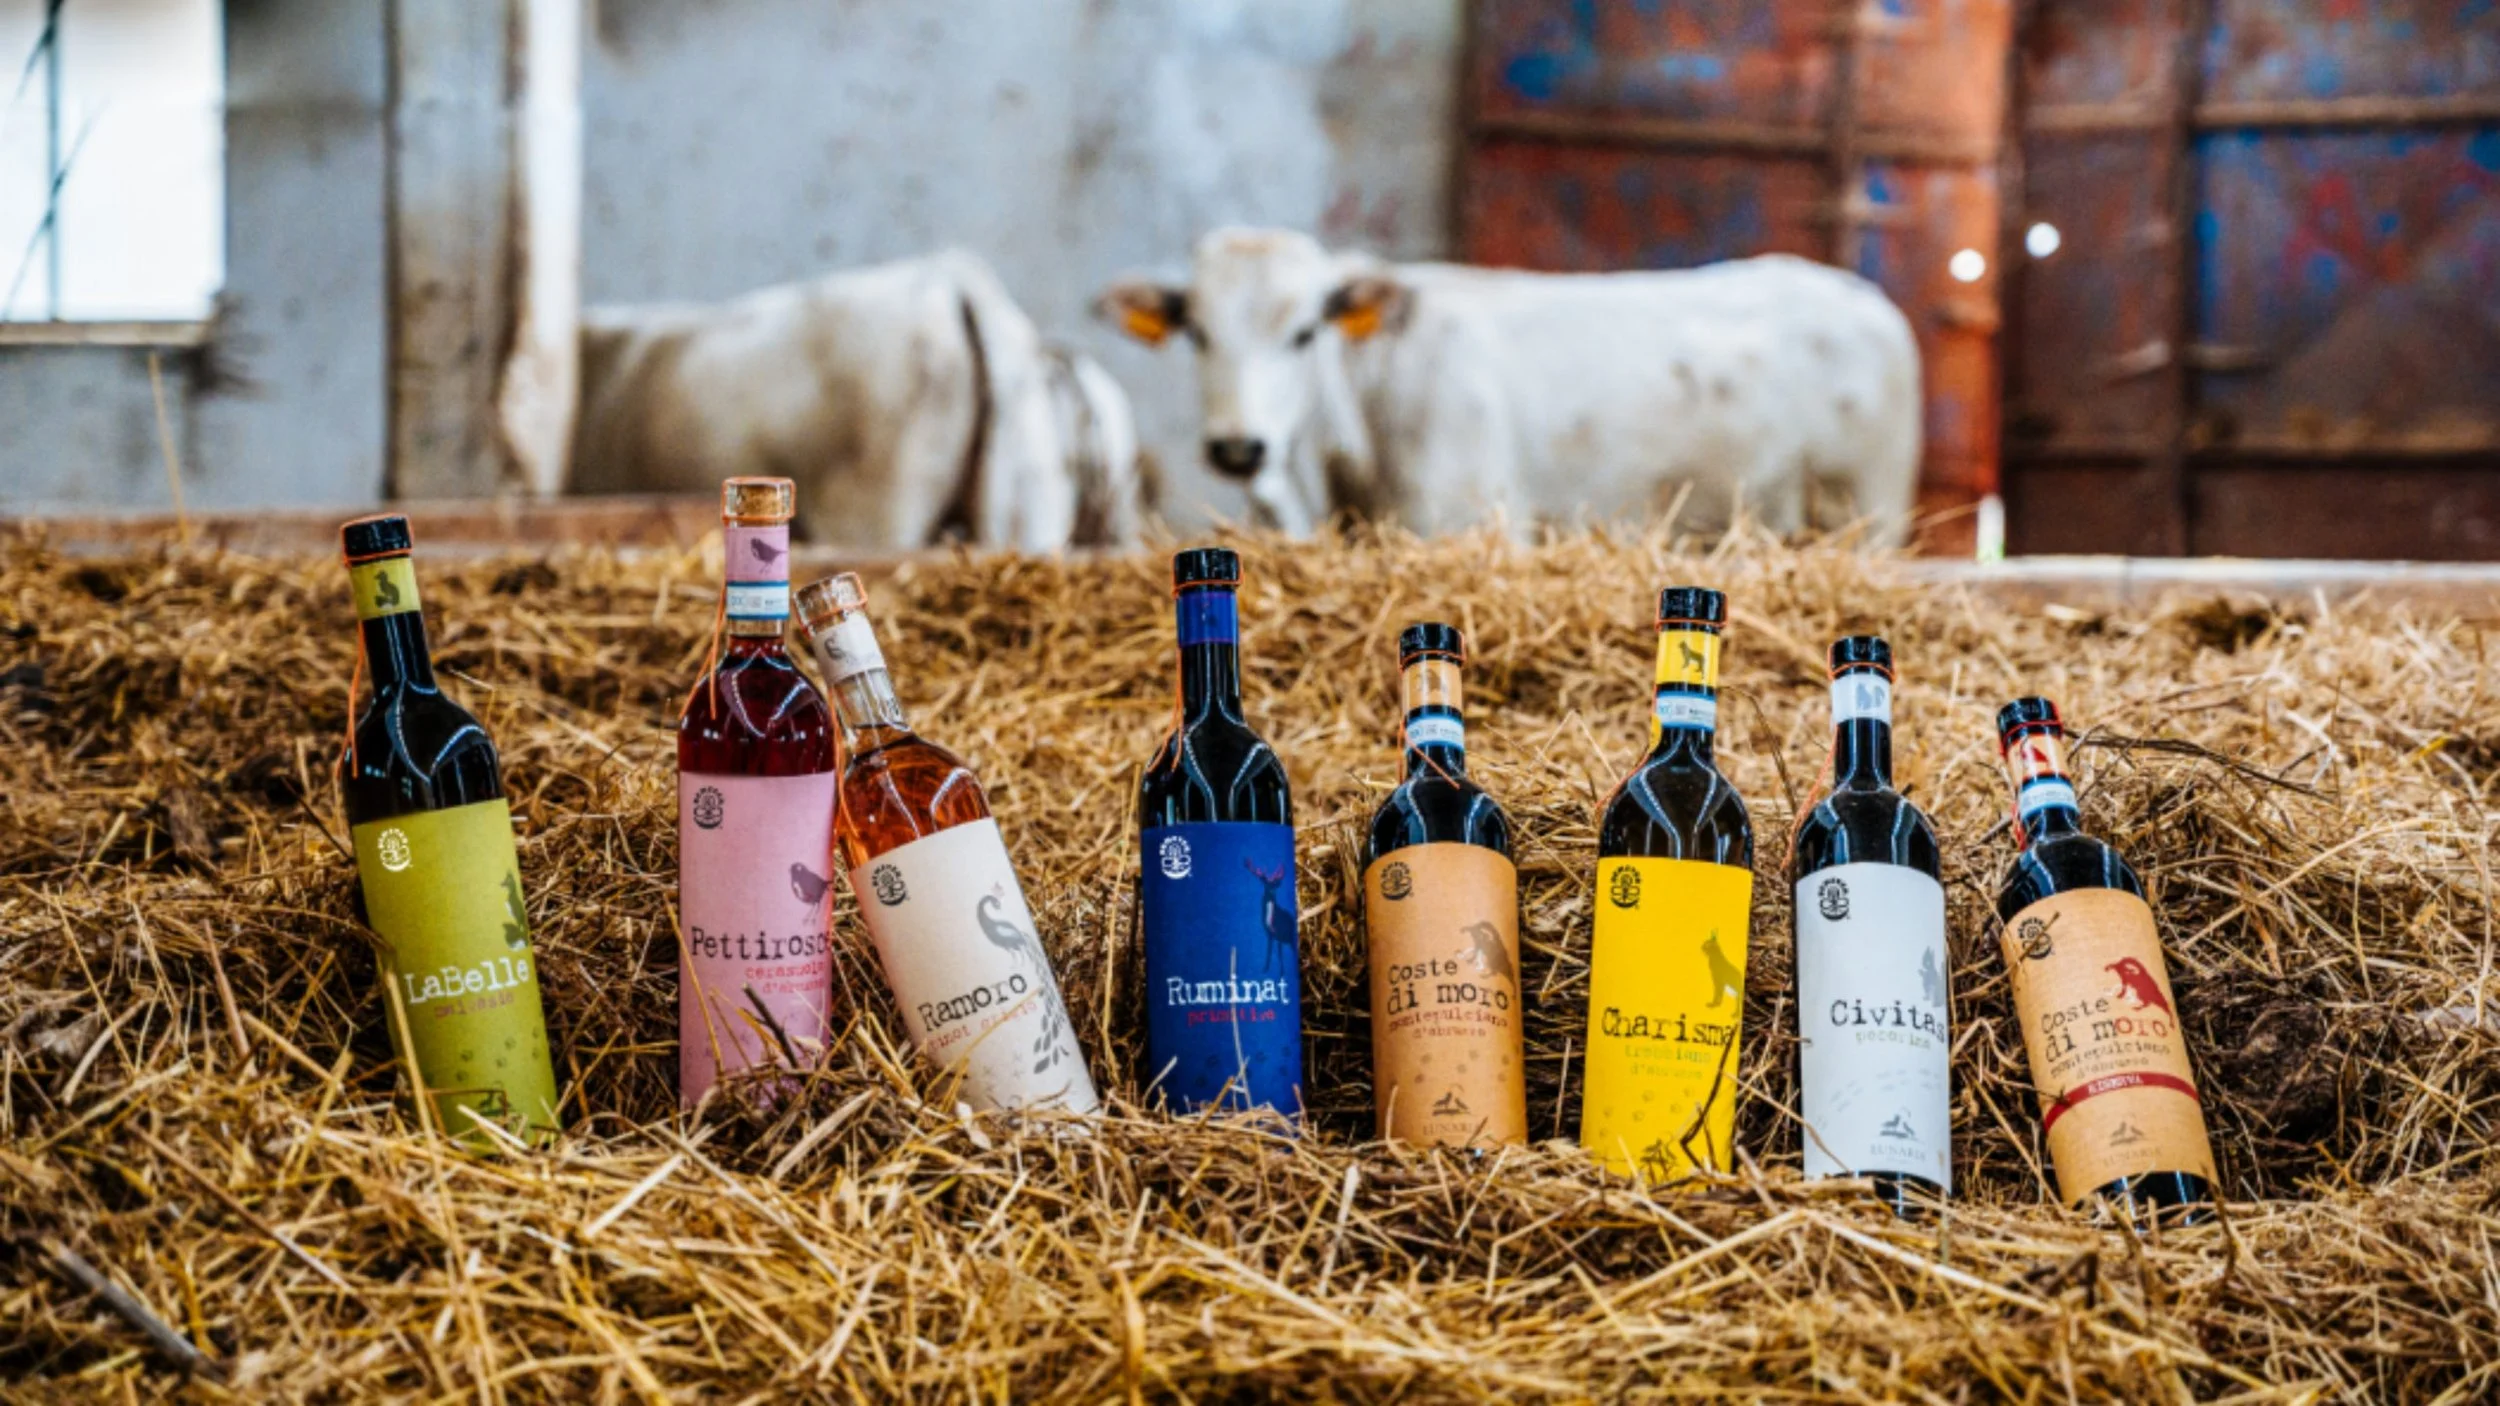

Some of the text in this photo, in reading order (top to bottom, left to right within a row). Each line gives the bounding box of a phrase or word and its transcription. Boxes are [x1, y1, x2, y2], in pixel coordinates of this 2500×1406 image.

[404, 957, 529, 1005] LaBelle
[1166, 973, 1290, 1006] Ruminat
[1388, 958, 1458, 985] Coste
[917, 973, 1028, 1032] Ramoro
[1387, 982, 1509, 1015] di moro
[2041, 996, 2109, 1035] Coste
[1830, 999, 1945, 1044] Civitas
[2045, 1016, 2168, 1063] di moro
